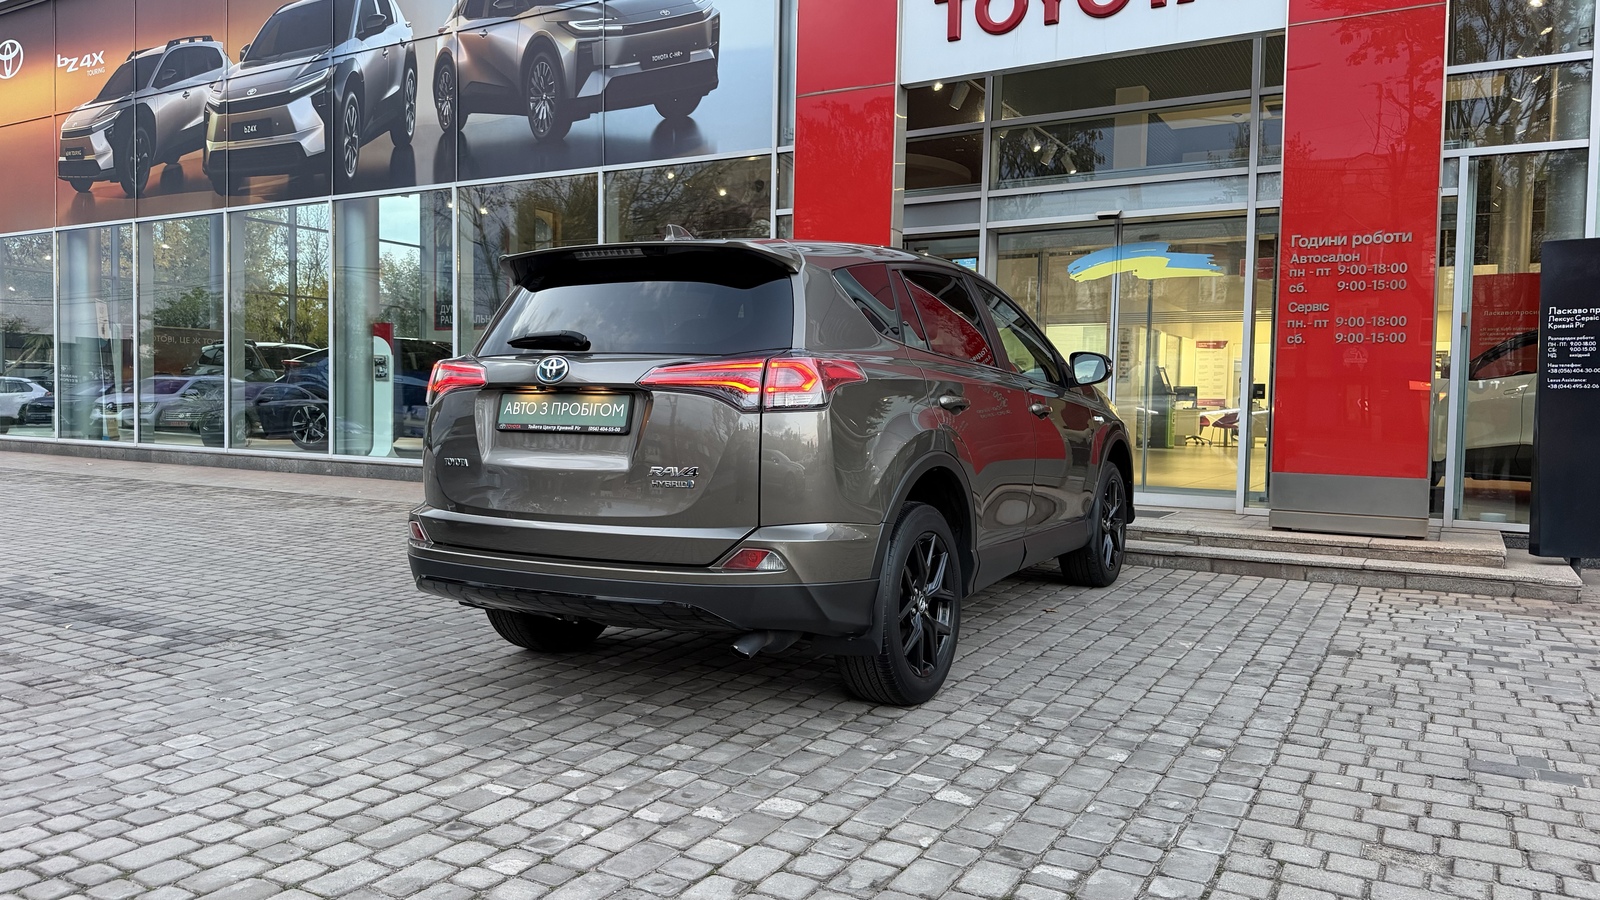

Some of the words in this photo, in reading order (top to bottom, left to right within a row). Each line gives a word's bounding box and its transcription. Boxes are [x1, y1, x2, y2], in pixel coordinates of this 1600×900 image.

[934, 0, 1195, 42] TOY
[1291, 234, 1347, 249] Години
[1352, 230, 1413, 248] роботи
[1290, 253, 1360, 264] Автосалон
[1316, 267, 1331, 276] пт
[1288, 282, 1308, 293] сб.
[1288, 302, 1329, 314] Сервіс
[1549, 307, 1588, 315] Ласкаво
[1549, 315, 1574, 323] Лексус
[1575, 314, 1600, 322] Сервіс
[1548, 322, 1574, 330] Кривий
[1287, 333, 1306, 344] сб.
[503, 401, 537, 415] АВТО
[551, 402, 625, 417] ПРОБІГОМ
[444, 457, 469, 467] TOYOTA
[648, 466, 699, 478] RAV4
[651, 480, 687, 488] HYBRID
